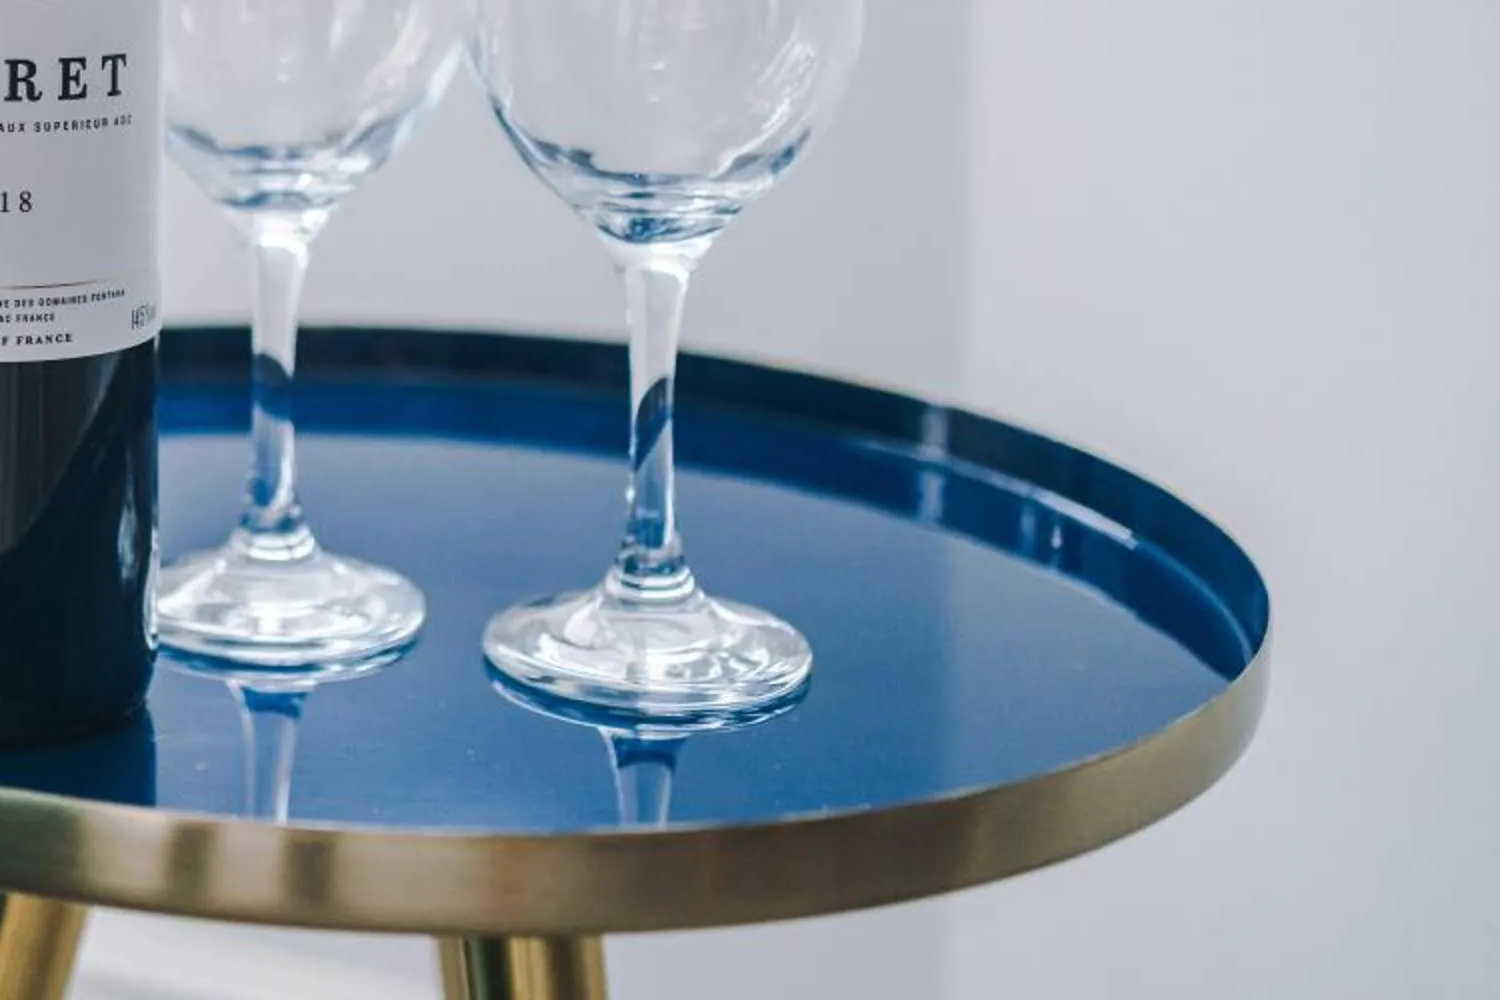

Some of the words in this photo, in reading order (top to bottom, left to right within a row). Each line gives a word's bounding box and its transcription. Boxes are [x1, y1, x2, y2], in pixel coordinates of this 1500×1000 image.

[38, 294, 88, 307] DOMAINES
[15, 312, 56, 323] FRANCE
[16, 333, 73, 346] FRANCE
